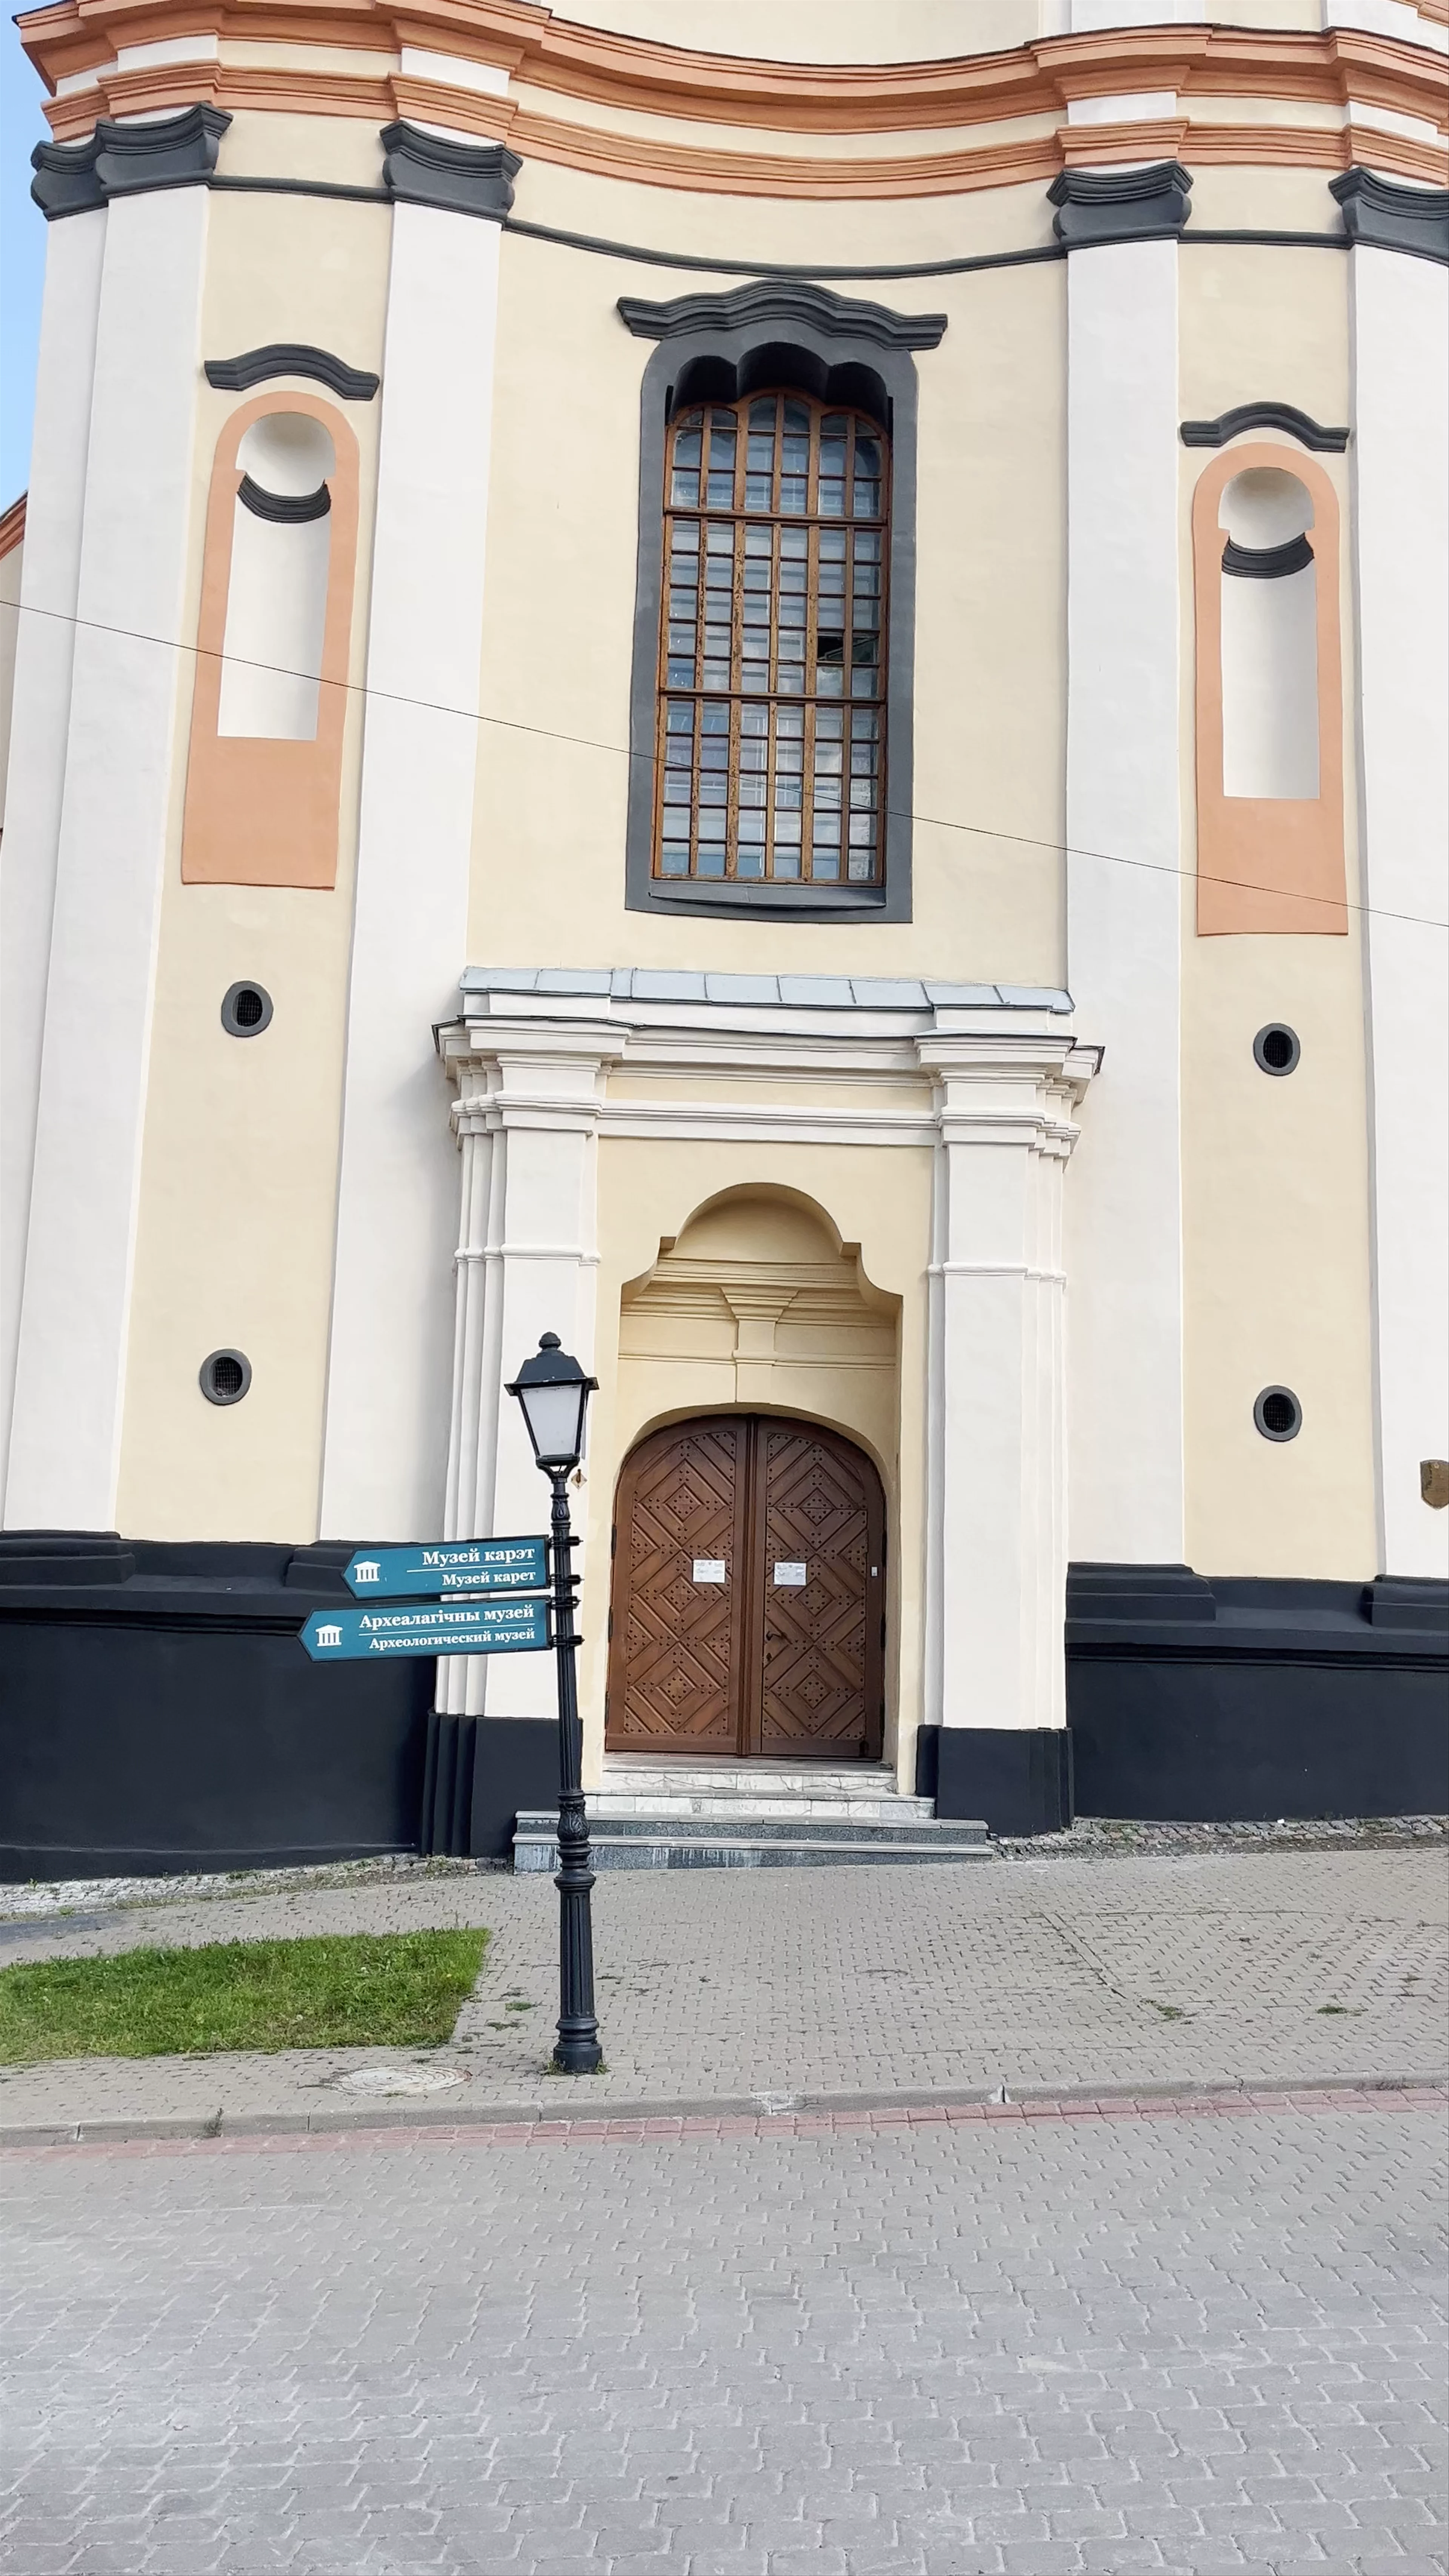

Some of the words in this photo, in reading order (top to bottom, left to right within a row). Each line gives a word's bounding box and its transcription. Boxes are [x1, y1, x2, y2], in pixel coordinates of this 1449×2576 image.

[422, 1548, 480, 1567] Музей
[485, 1548, 535, 1564] карэт
[442, 1572, 490, 1587] Музей
[494, 1572, 536, 1584] карет
[359, 1610, 480, 1630] Археалагічны
[484, 1604, 534, 1623] музей
[369, 1630, 492, 1651] Археологический
[494, 1628, 535, 1642] музей
